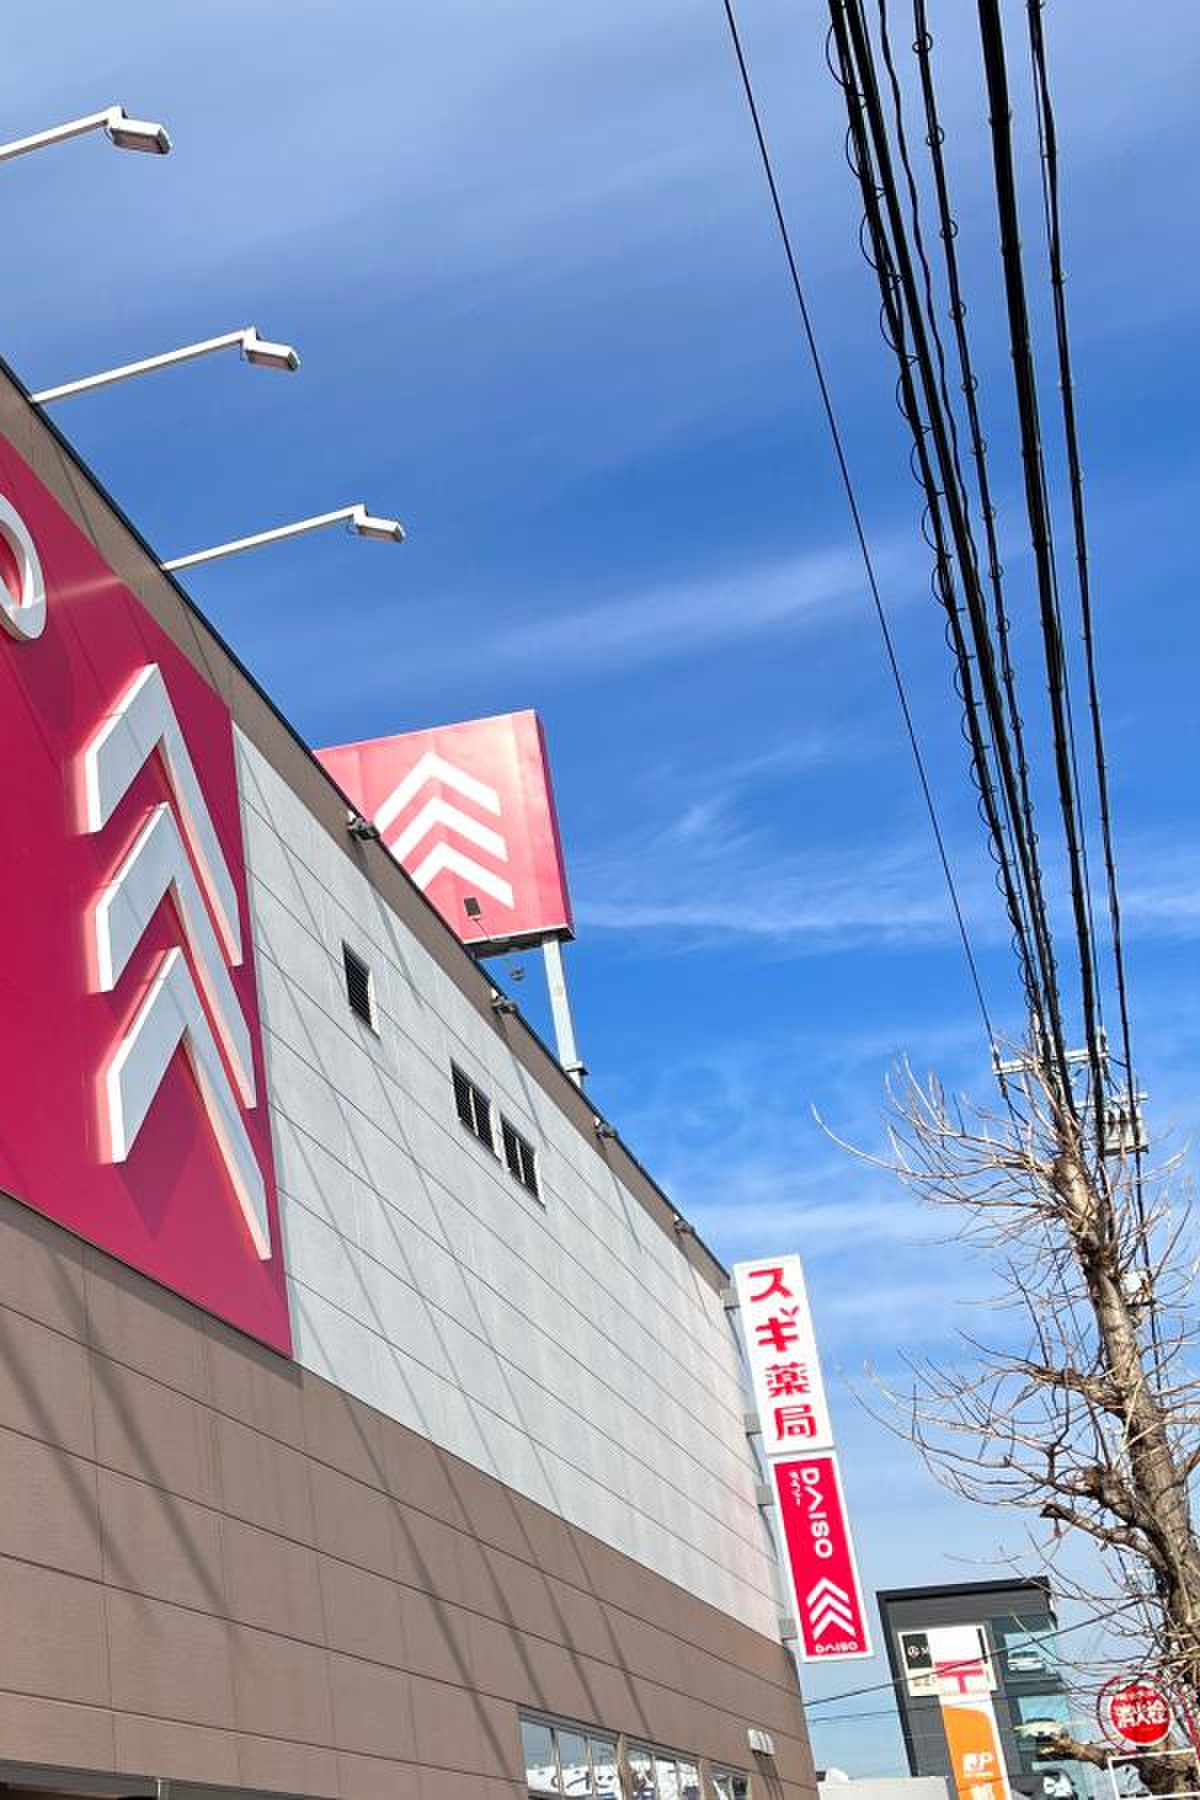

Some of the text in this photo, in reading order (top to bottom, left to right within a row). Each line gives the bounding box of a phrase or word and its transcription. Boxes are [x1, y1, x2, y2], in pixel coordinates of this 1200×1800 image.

[747, 1266, 818, 1441] スギ薬局
[801, 1466, 834, 1559] DAISO
